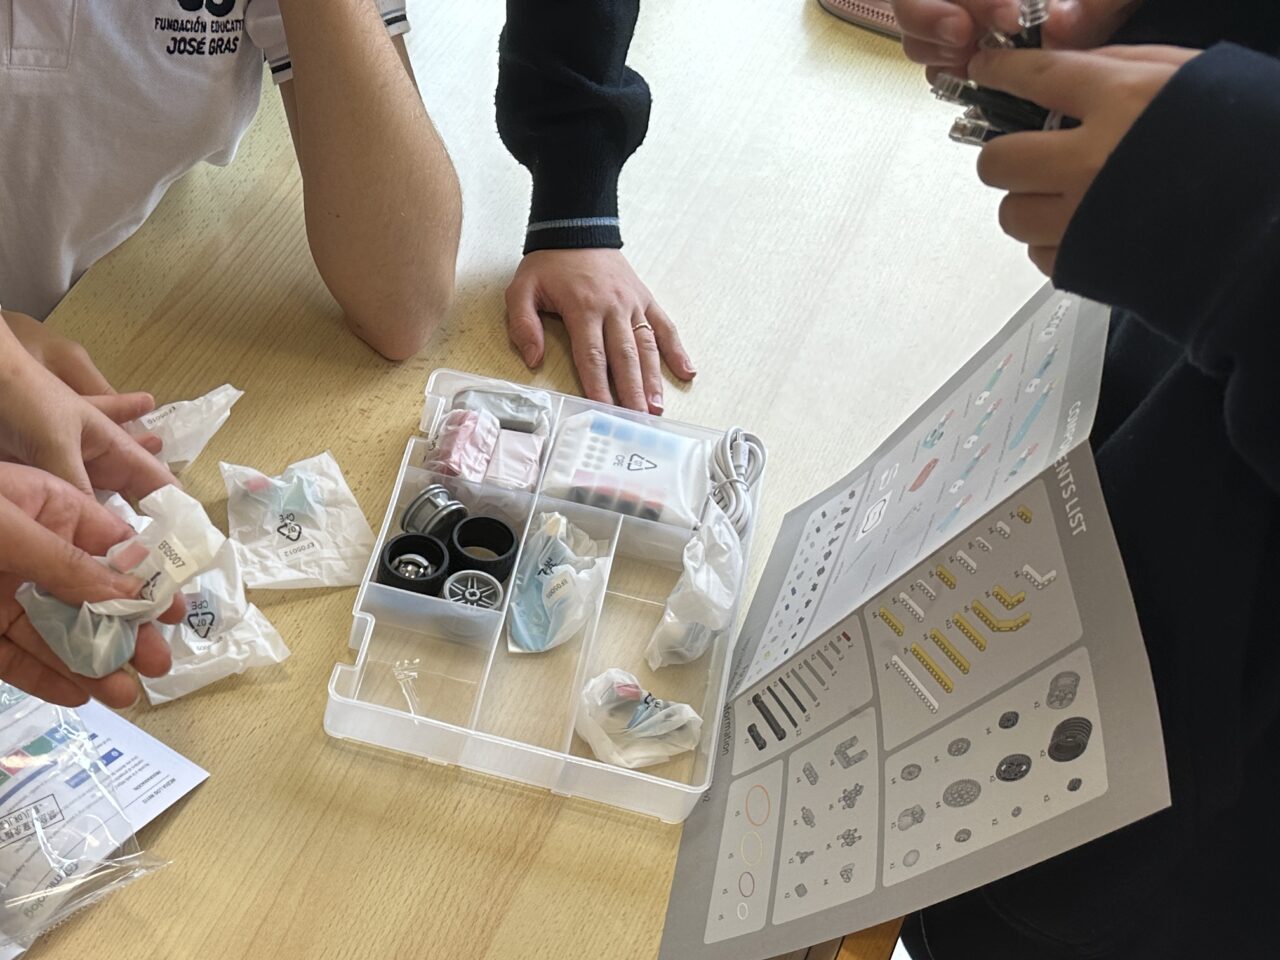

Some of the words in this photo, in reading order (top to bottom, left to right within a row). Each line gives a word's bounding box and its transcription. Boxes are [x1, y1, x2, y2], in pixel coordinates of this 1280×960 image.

[155, 16, 206, 33] FUNDACIÓN
[167, 37, 206, 55] JOSÉ
[208, 36, 239, 55] GRAS
[1063, 496, 1087, 536] LIST
[191, 599, 208, 609] CPE
